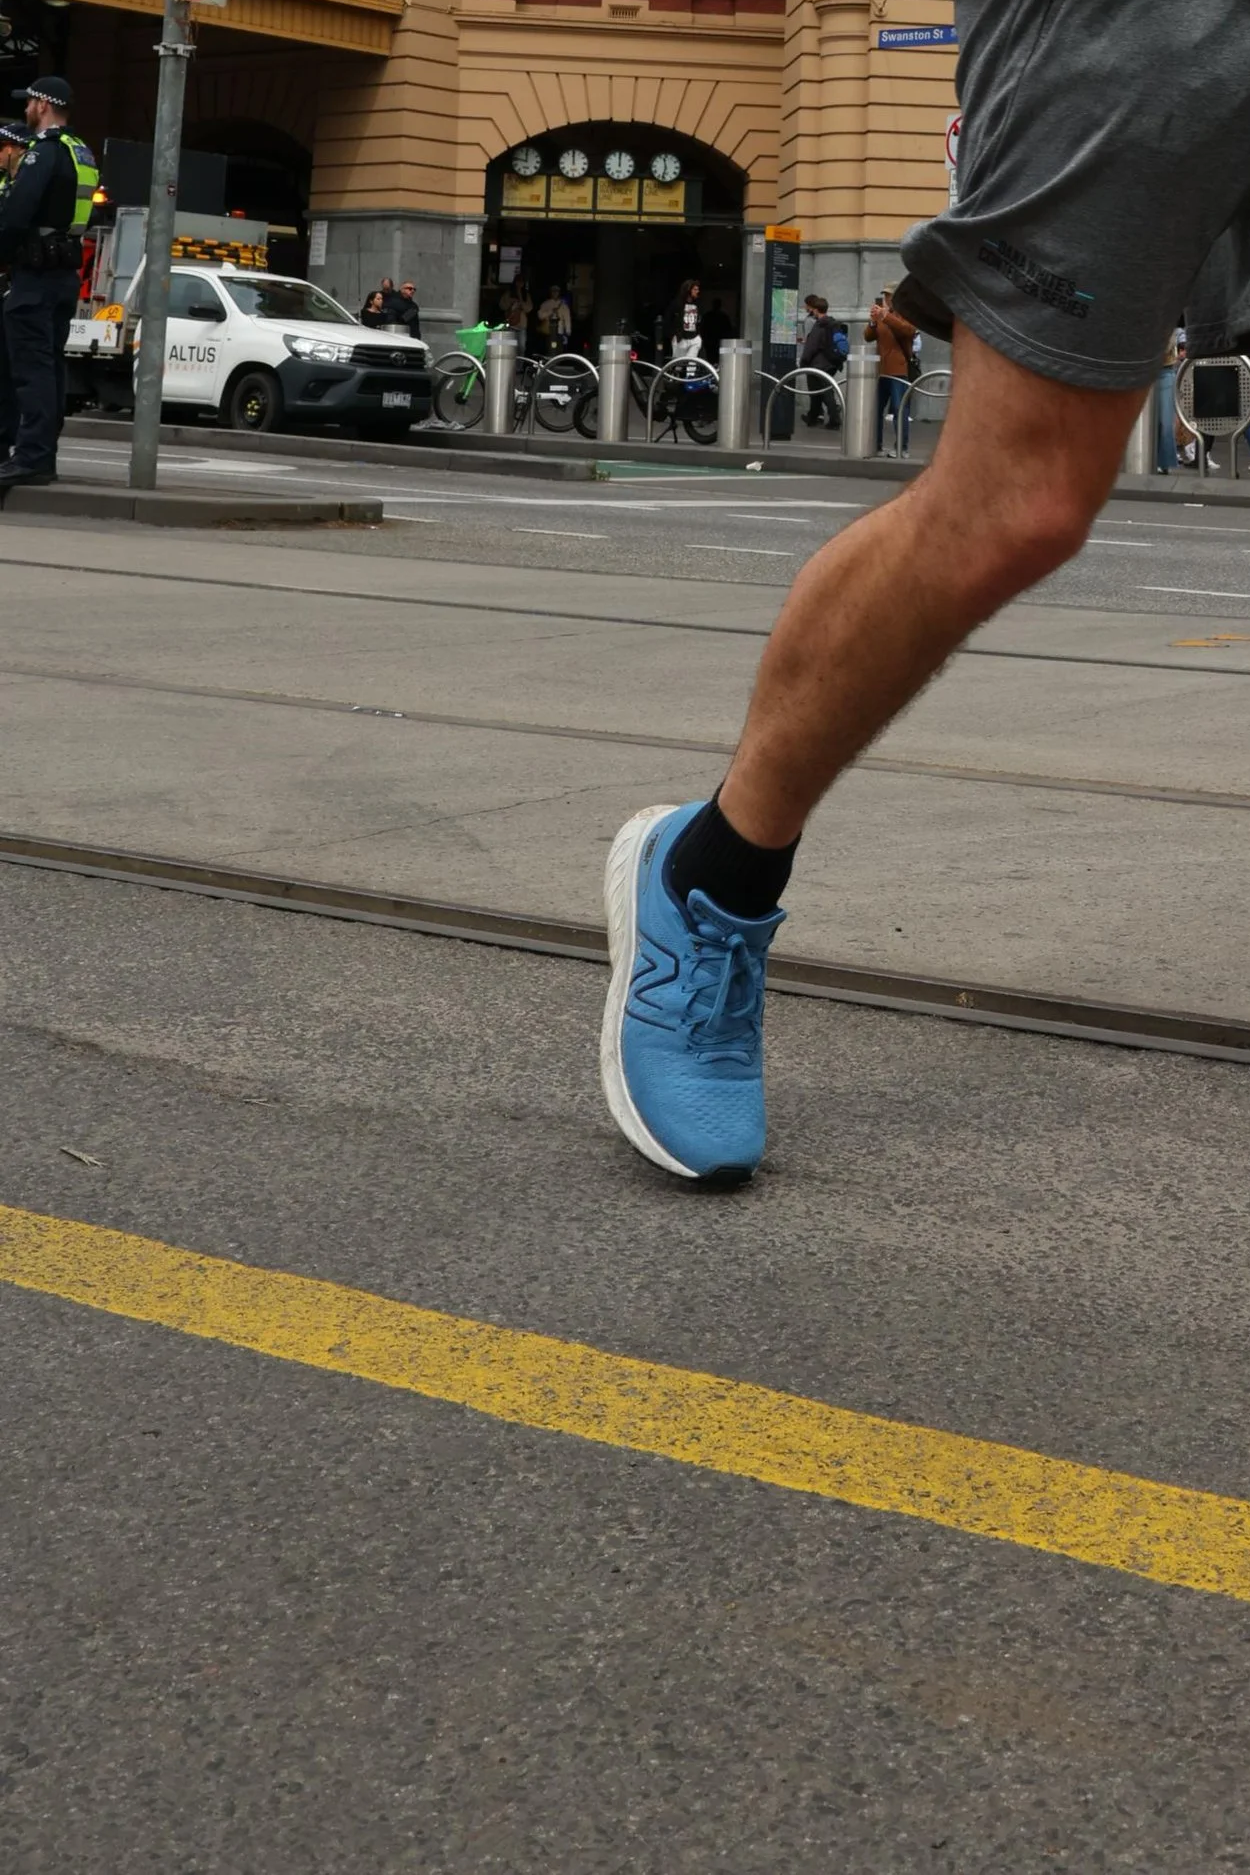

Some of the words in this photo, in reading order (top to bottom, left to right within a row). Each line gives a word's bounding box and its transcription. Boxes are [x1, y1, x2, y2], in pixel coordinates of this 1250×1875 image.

[881, 30, 931, 42] Swanston
[932, 28, 944, 39] St
[169, 344, 216, 363] ALTUS
